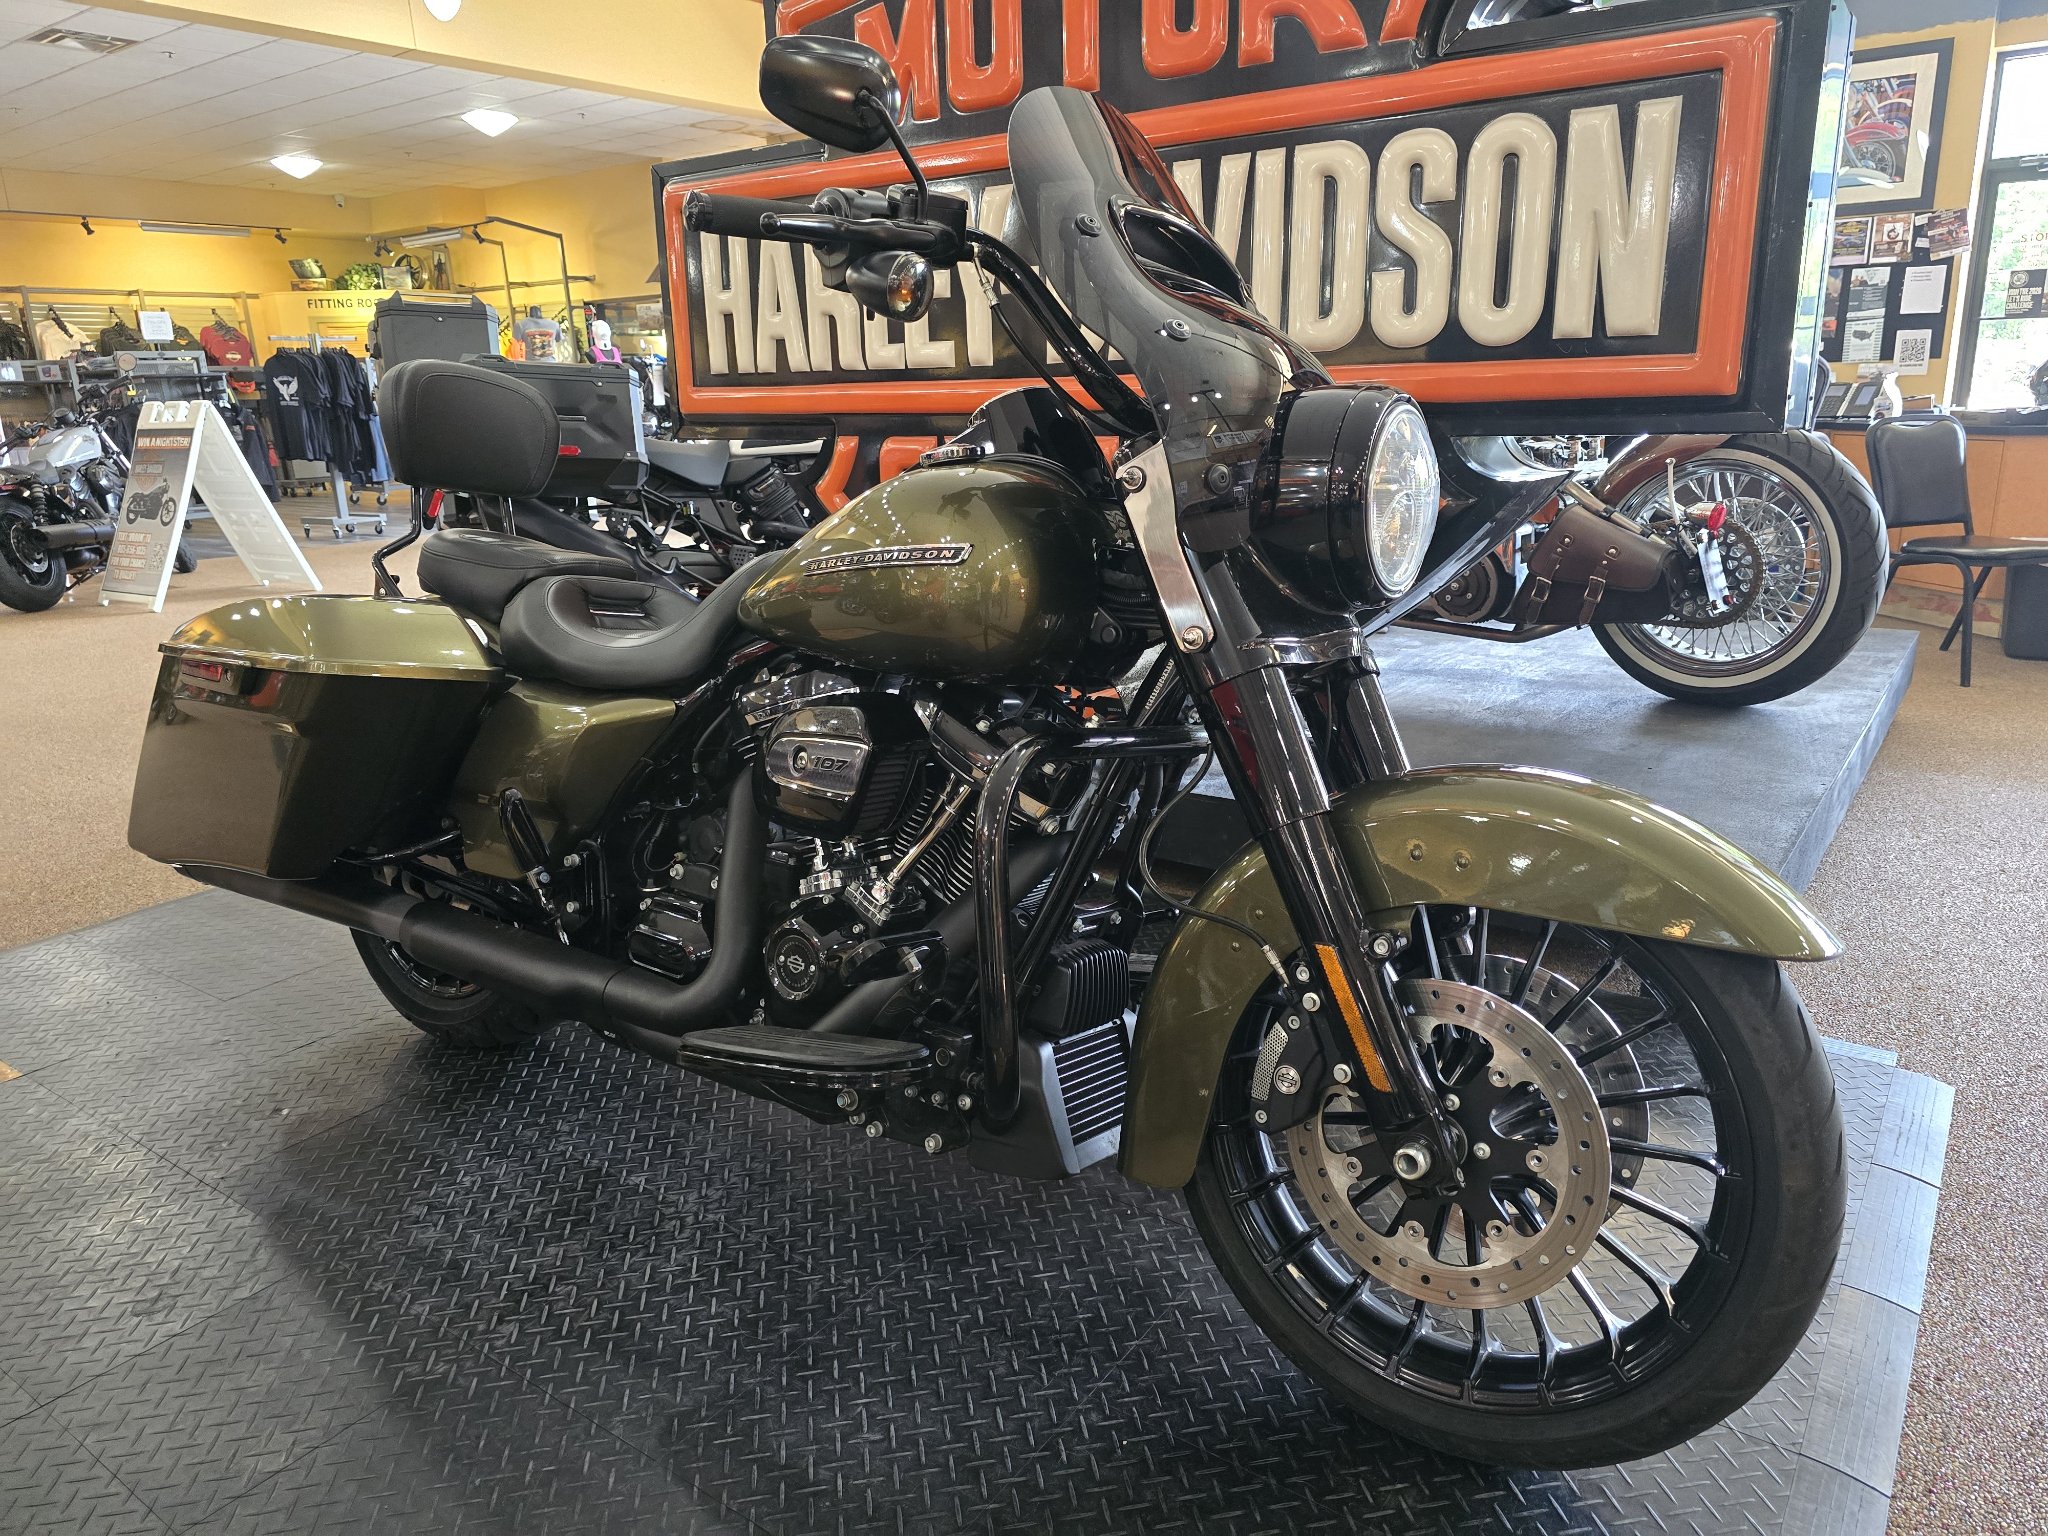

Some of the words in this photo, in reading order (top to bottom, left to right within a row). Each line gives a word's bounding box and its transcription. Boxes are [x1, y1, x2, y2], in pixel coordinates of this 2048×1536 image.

[307, 298, 353, 309] FITTING
[809, 549, 955, 570] HARLEY-DAVIDSON
[812, 755, 851, 773] 107
